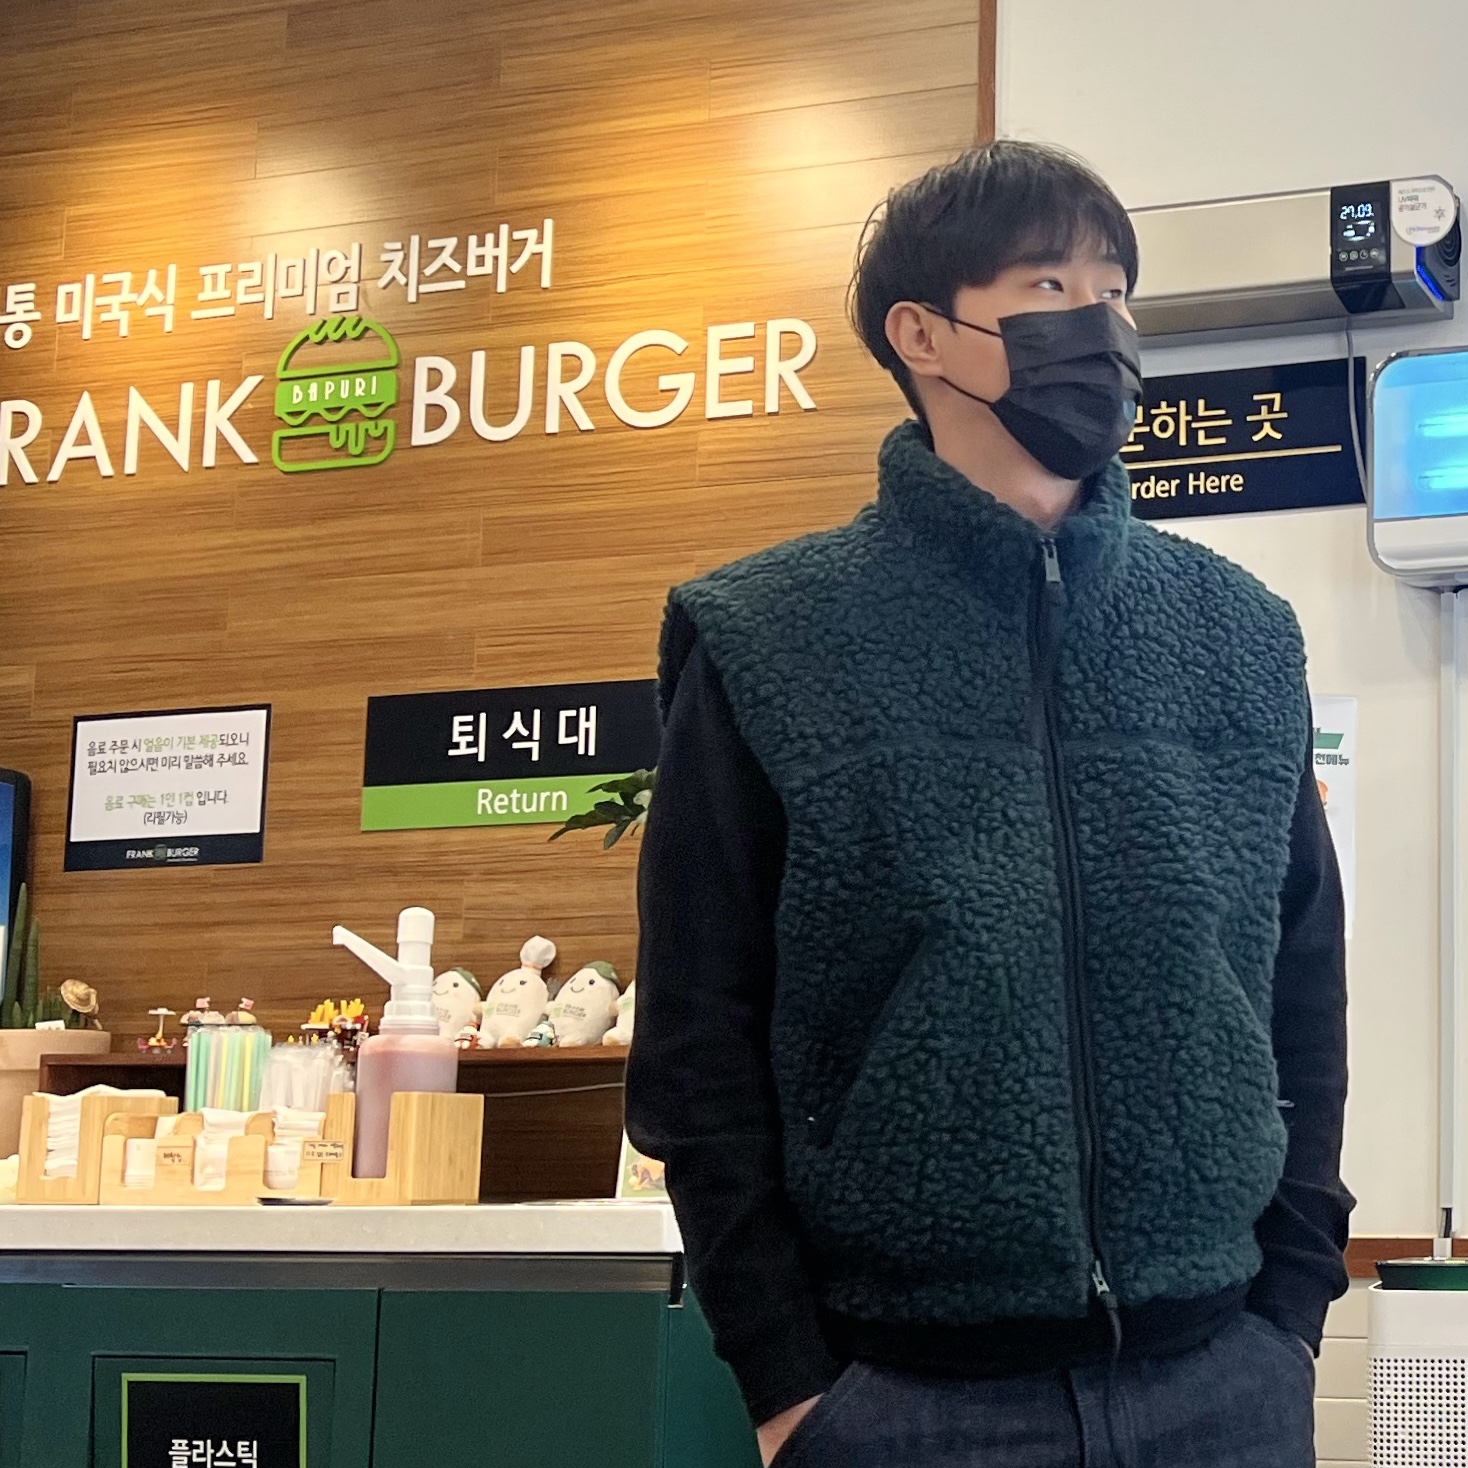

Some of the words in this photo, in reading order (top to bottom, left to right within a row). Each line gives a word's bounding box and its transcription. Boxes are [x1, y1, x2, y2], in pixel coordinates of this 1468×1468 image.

[0, 282, 42, 349] 통
[56, 263, 176, 341] 미국식
[190, 241, 361, 321] 프리미엄
[377, 217, 554, 303] 치즈버거
[0, 374, 264, 486] RANK
[411, 317, 818, 447] BURGER
[292, 375, 378, 404] BAPURI
[1119, 398, 1233, 453] 하는
[1246, 392, 1289, 443] 곳
[1131, 474, 1181, 501] rder
[1188, 471, 1245, 496] Here
[87, 741, 107, 757] 음료
[108, 739, 130, 755] 주문
[131, 738, 142, 752] 시
[177, 734, 197, 750] 기본
[447, 704, 598, 763] 퇴식대
[161, 755, 181, 771] 미리
[183, 753, 214, 770] 말씀해
[1314, 752, 1351, 765] 천메뉴
[476, 788, 569, 816] Return
[143, 809, 189, 827] (리필가능)
